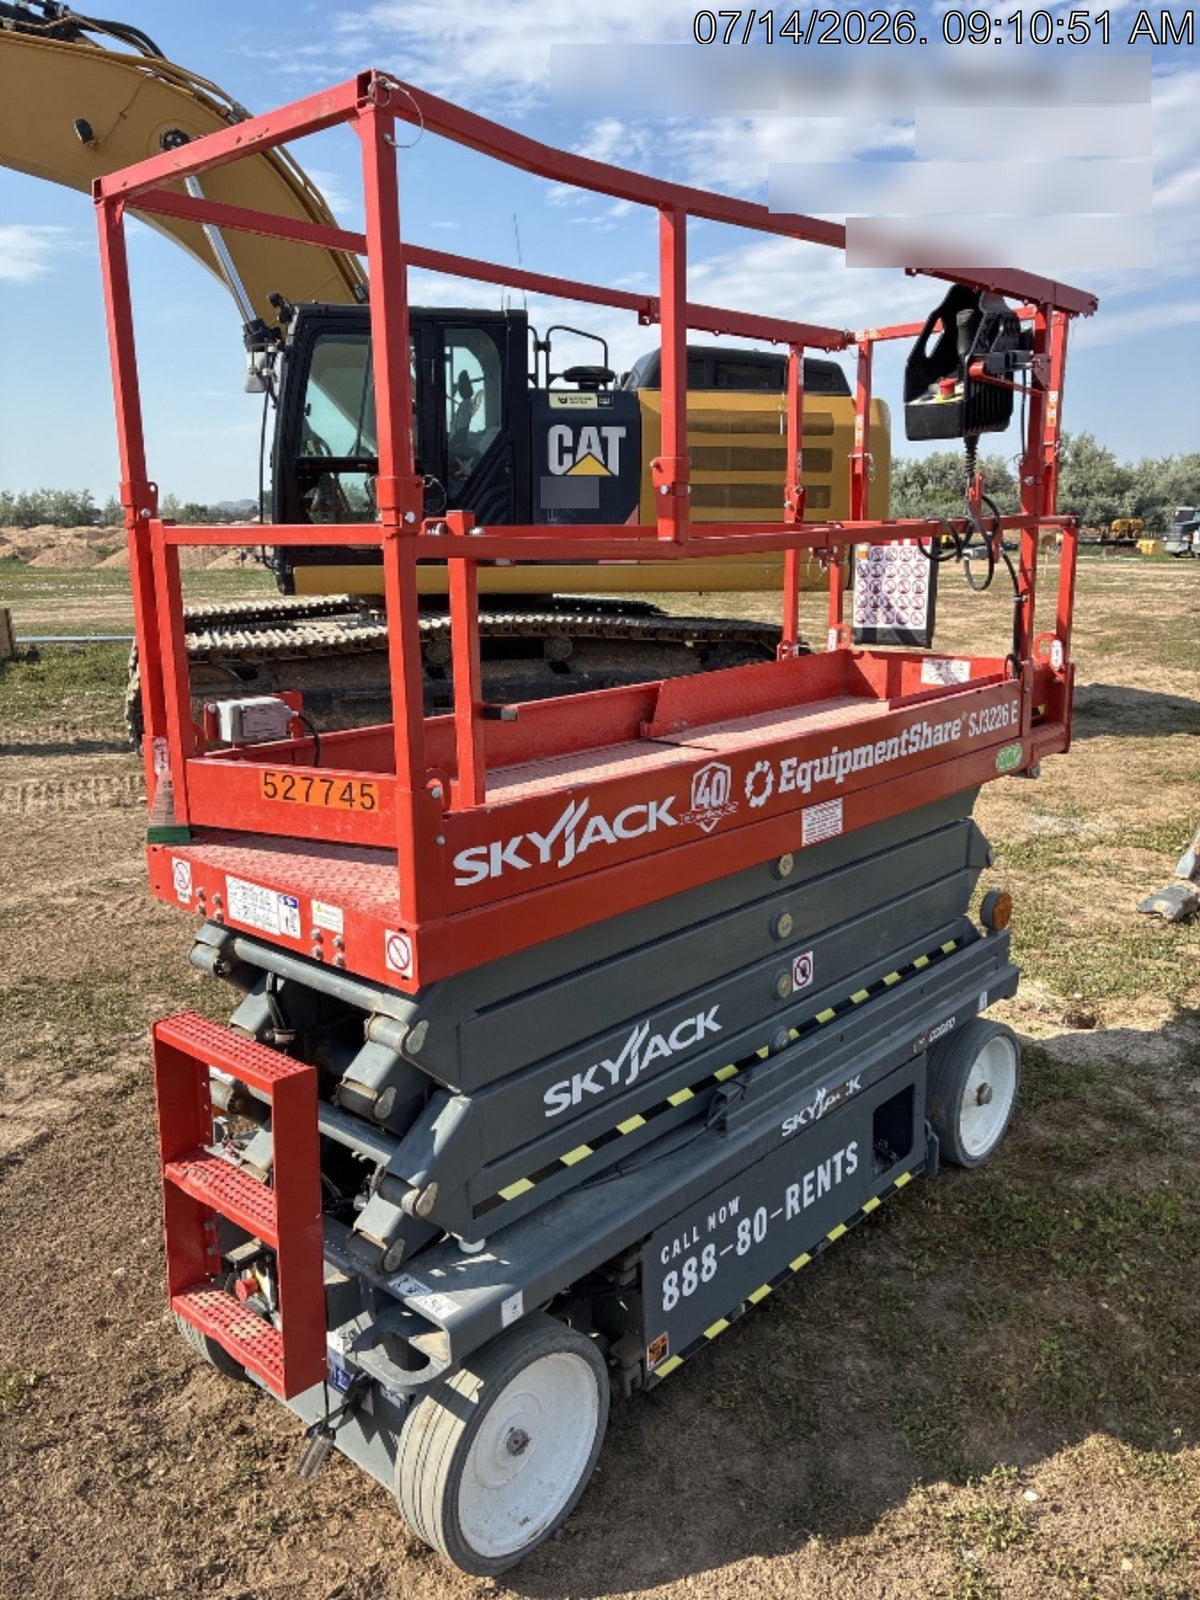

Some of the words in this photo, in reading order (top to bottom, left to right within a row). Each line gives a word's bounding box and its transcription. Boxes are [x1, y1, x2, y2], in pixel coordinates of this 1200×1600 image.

[547, 424, 626, 476] CAT
[968, 703, 1009, 738] SJ3226
[778, 718, 961, 794] EquipmentShare
[263, 772, 376, 811] 527745
[694, 770, 727, 809] 40
[453, 796, 678, 886] SKYJACK
[543, 1004, 722, 1118] SKYJACK
[781, 1074, 862, 1137] SKYJAK
[660, 1226, 700, 1264] CALL
[707, 1196, 740, 1232] NOW
[662, 1141, 858, 1312] 888-80-RENTS
